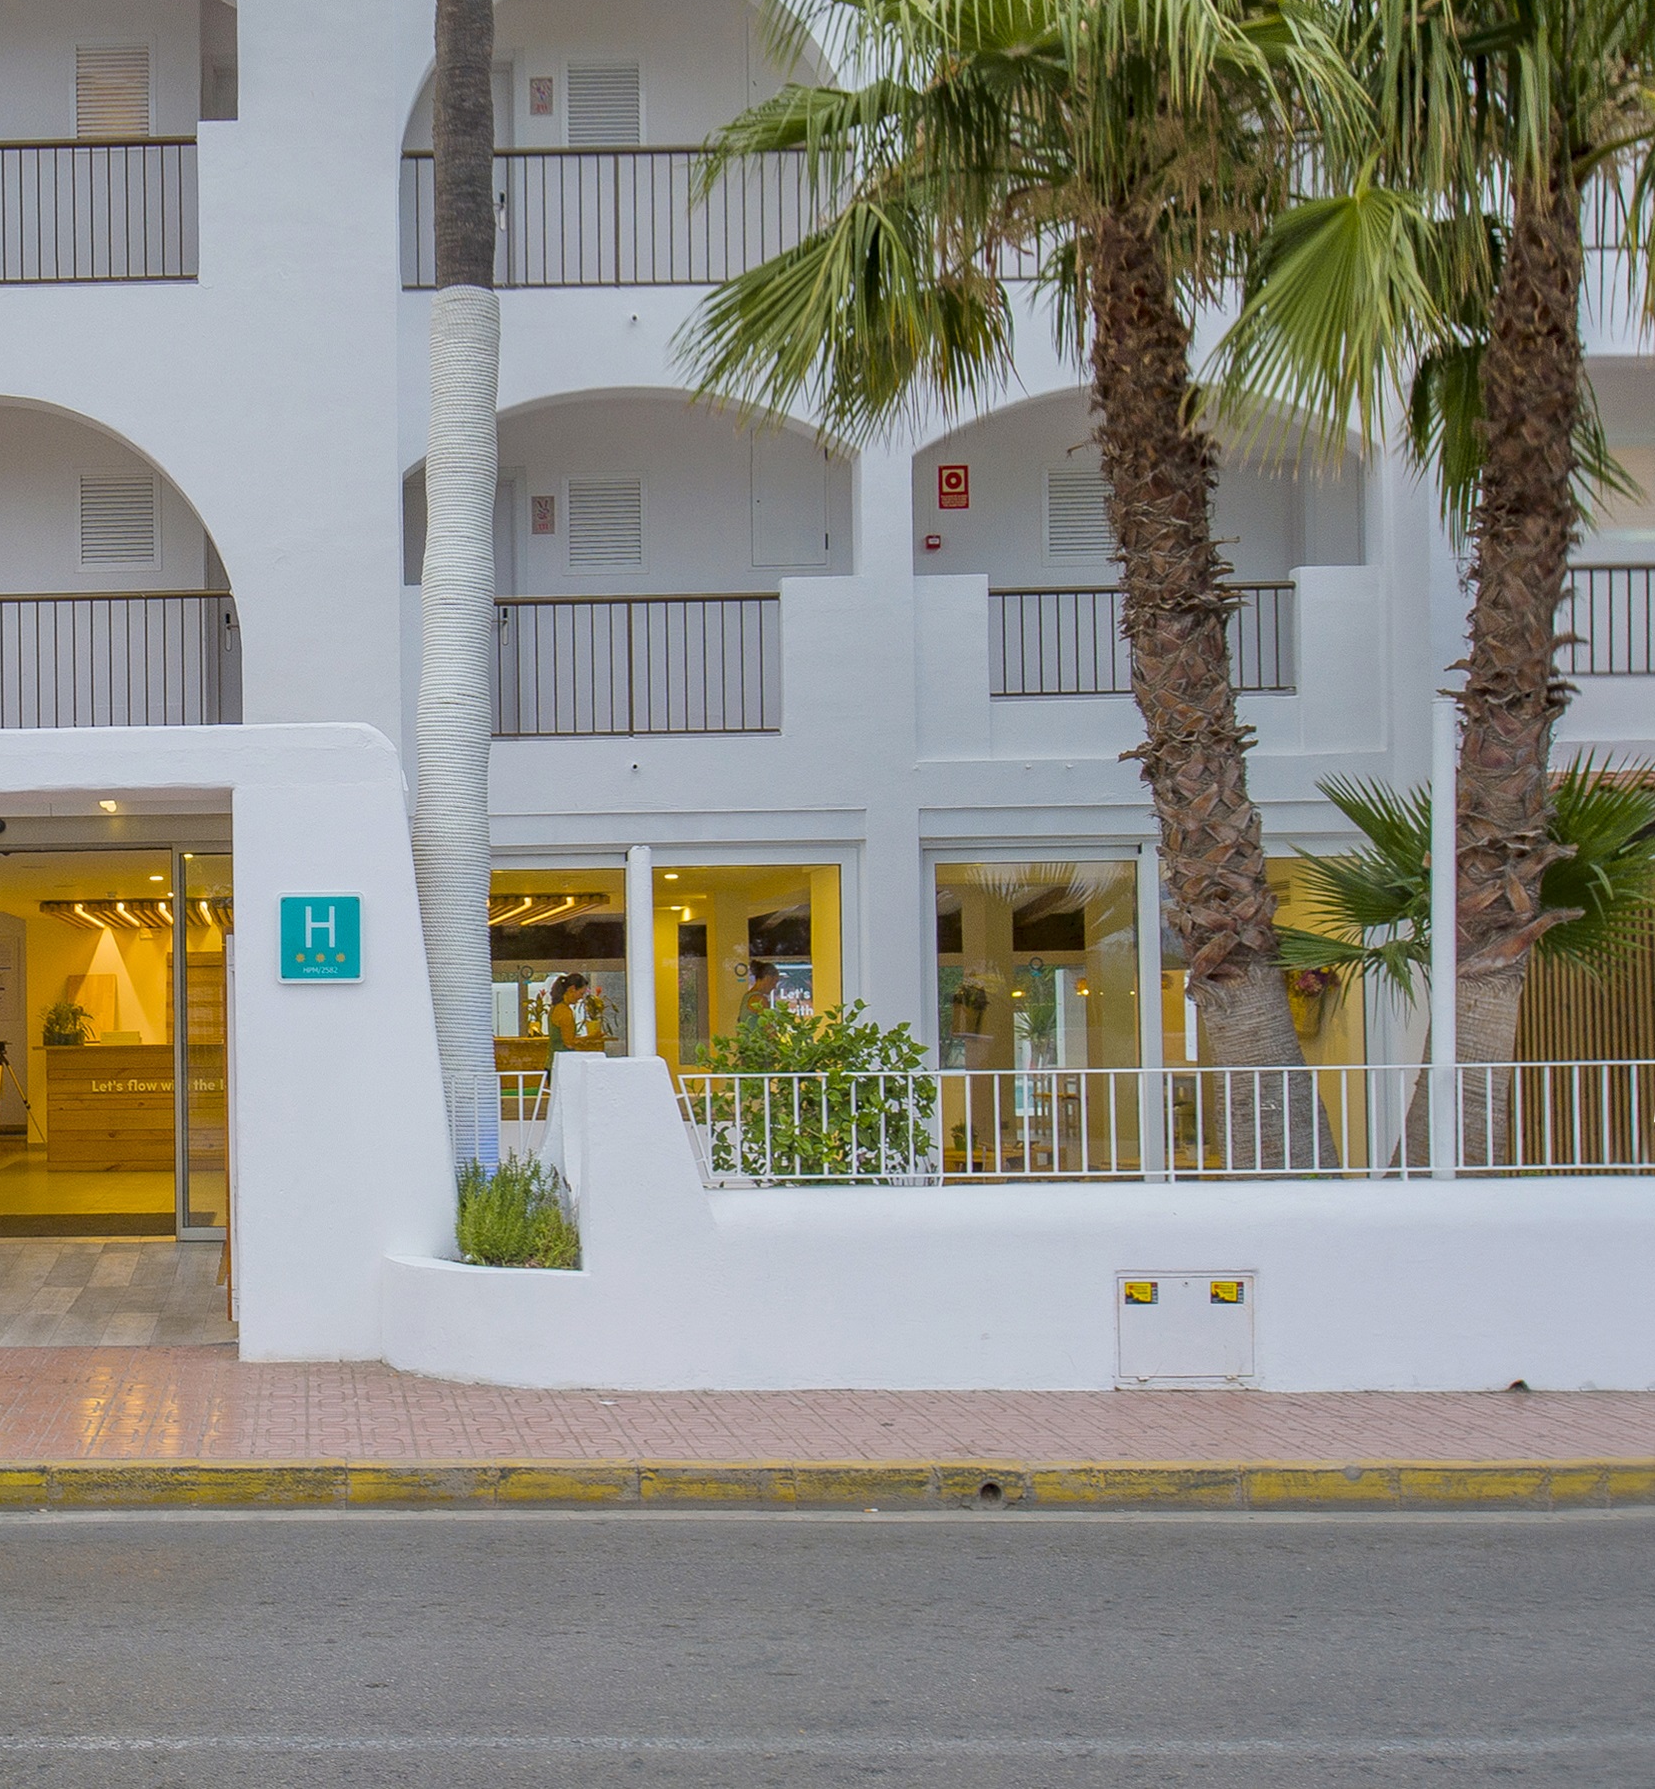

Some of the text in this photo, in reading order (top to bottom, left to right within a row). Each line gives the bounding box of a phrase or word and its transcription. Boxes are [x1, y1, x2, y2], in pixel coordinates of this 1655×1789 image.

[305, 905, 336, 948] H
[780, 987, 811, 999] Let's
[91, 1080, 123, 1092] Let's
[127, 1079, 157, 1091] flow
[193, 1078, 216, 1090] the
